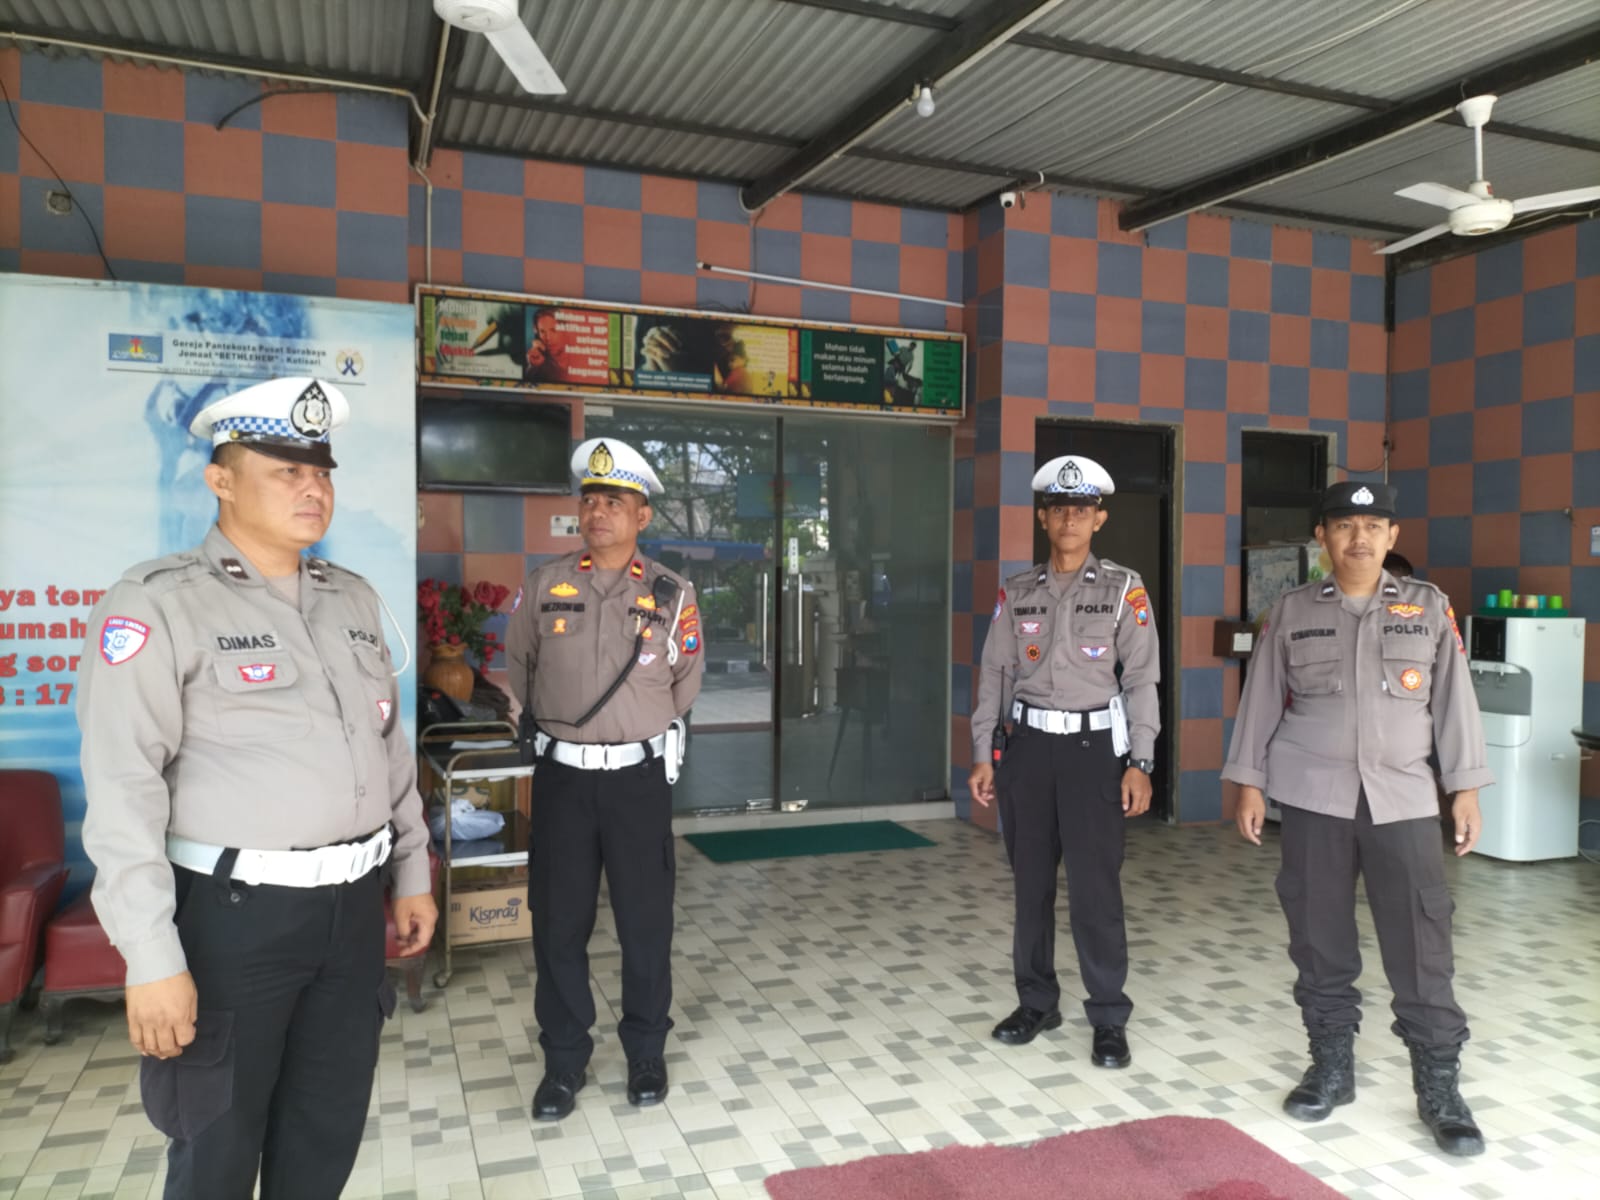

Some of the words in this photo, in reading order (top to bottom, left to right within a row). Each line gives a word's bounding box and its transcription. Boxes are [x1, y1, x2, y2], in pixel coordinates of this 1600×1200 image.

[555, 311, 585, 322] Mohon
[172, 338, 203, 350] Gereja
[286, 346, 327, 358] Surabaya
[825, 343, 848, 352] Mohon
[178, 350, 212, 359] Jemaat
[287, 356, 321, 366] Kutisari
[1075, 604, 1113, 614] POLRI
[1383, 624, 1429, 636] POLRI
[217, 634, 277, 650] DIMAS
[36, 683, 73, 705] 17
[469, 906, 519, 923] Kispray
